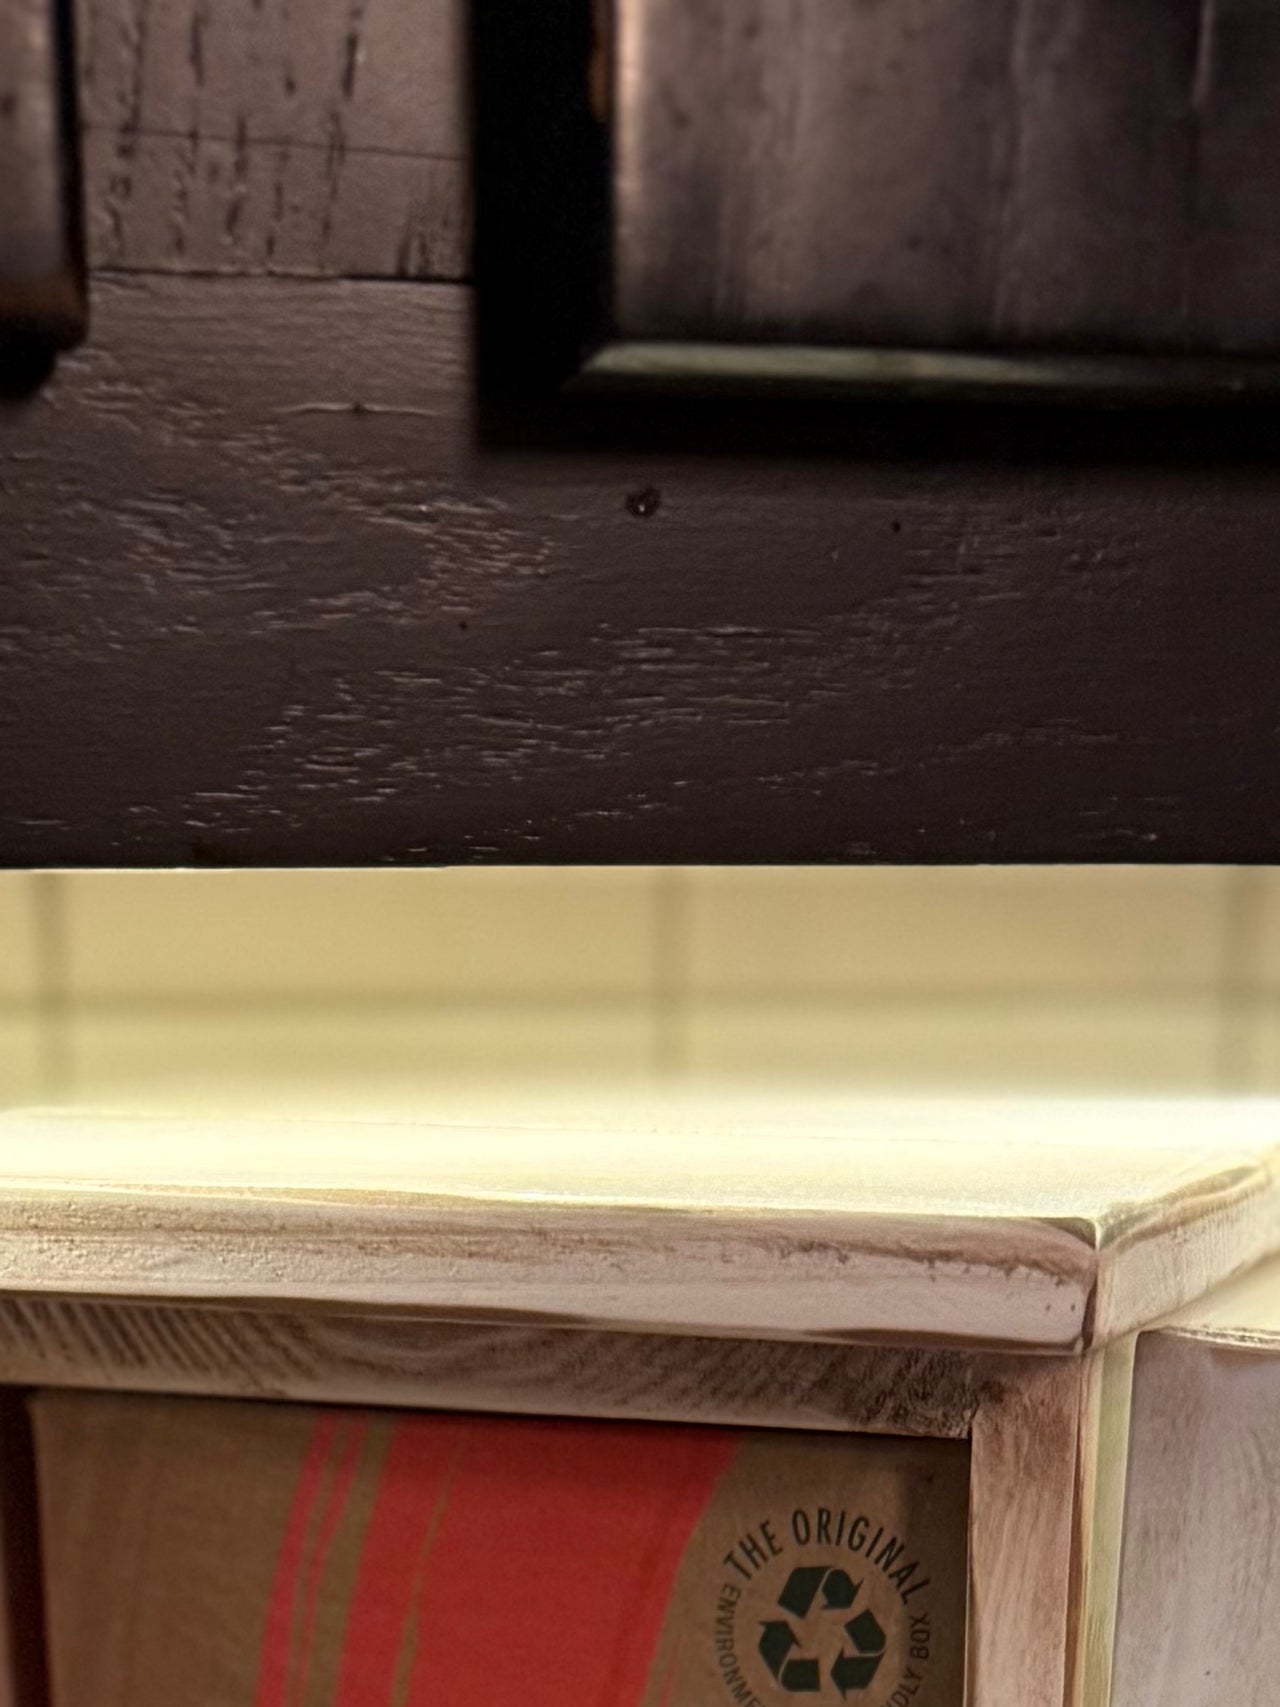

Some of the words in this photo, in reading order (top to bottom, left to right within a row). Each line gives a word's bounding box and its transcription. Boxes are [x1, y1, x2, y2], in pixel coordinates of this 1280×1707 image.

[722, 1520, 784, 1581] THE
[791, 1507, 931, 1606] ORIGINAL
[907, 1612, 931, 1661] BOX
